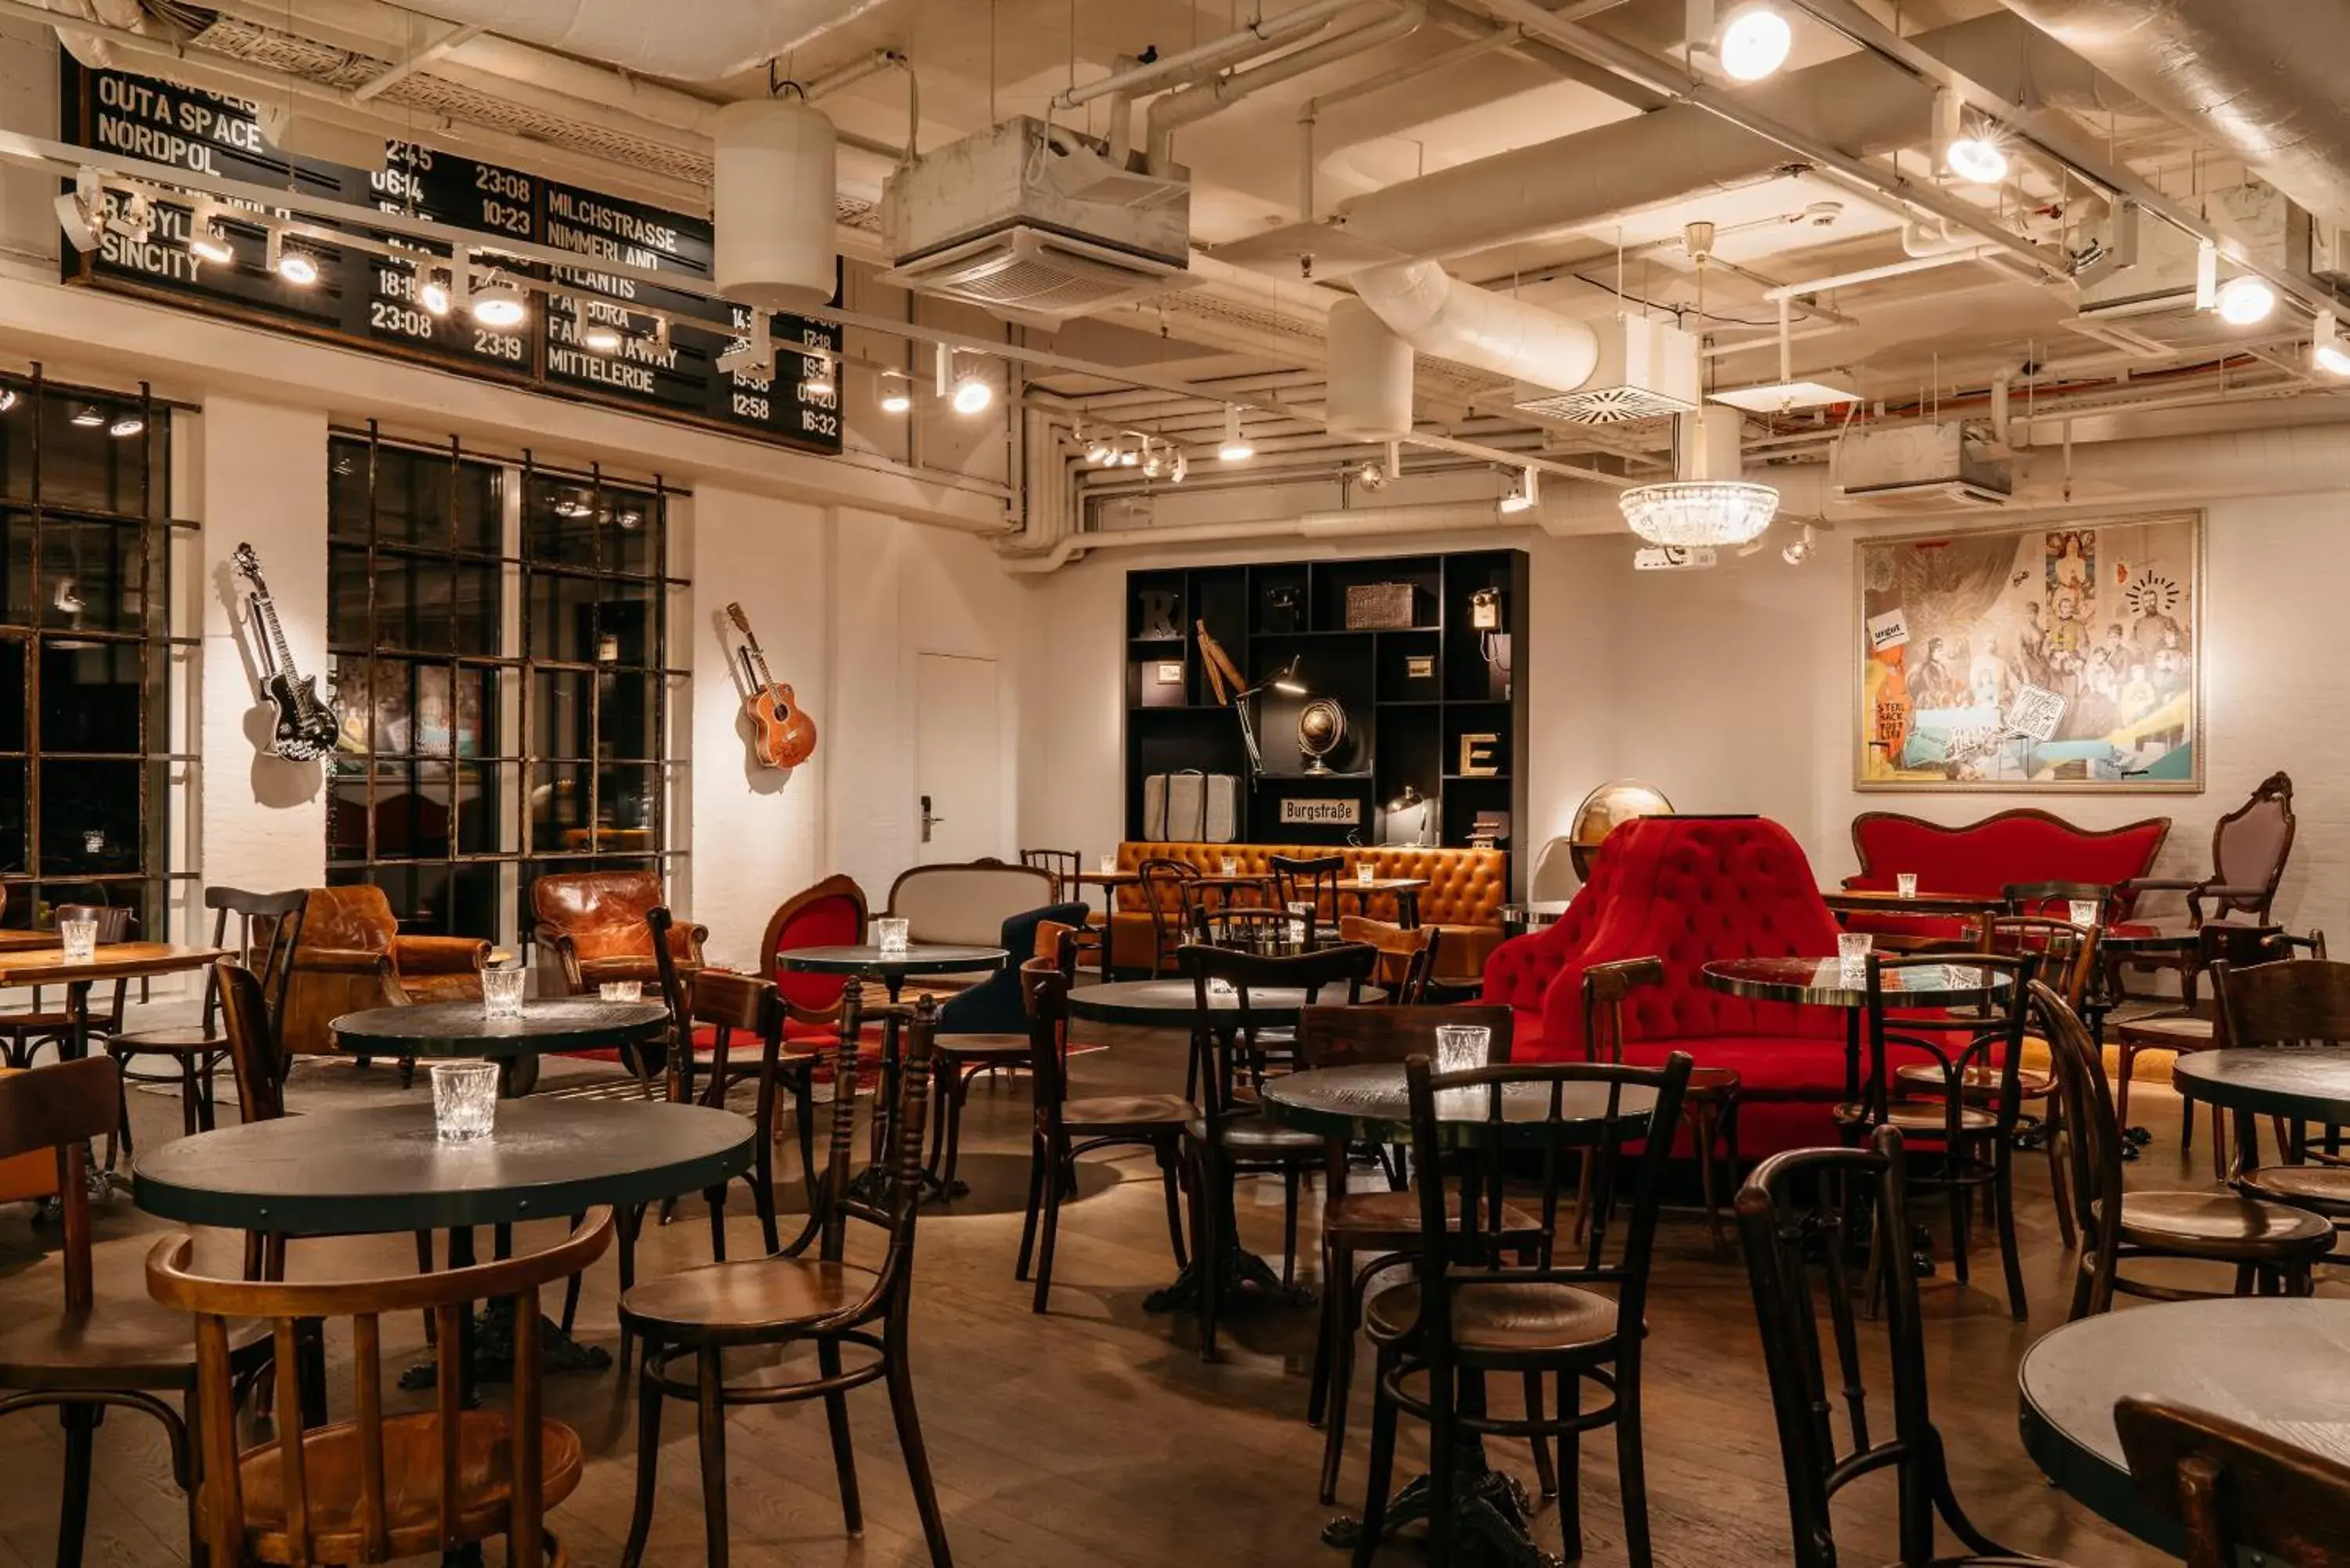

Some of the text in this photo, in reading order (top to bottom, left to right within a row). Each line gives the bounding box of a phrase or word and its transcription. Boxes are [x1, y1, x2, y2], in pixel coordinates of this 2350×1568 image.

[99, 76, 172, 125] OUTA
[179, 103, 263, 154] SPACE
[99, 114, 221, 176] NORDPOL
[371, 169, 425, 202] 06:14
[475, 165, 530, 203] 23:08
[483, 198, 530, 234] 10:23
[548, 190, 678, 252] MILCHSTRASSE
[101, 233, 201, 282] SINCITY
[380, 269, 417, 301] 18:1
[550, 262, 636, 298] ATLANTIS
[371, 302, 432, 338] 23:08
[474, 328, 522, 360] 23:19
[548, 345, 655, 393] MITTELERDE
[732, 392, 769, 419] 12:58
[802, 409, 837, 436] 16:32
[1459, 733, 1499, 776] E
[1287, 801, 1353, 820] Burgstraße
